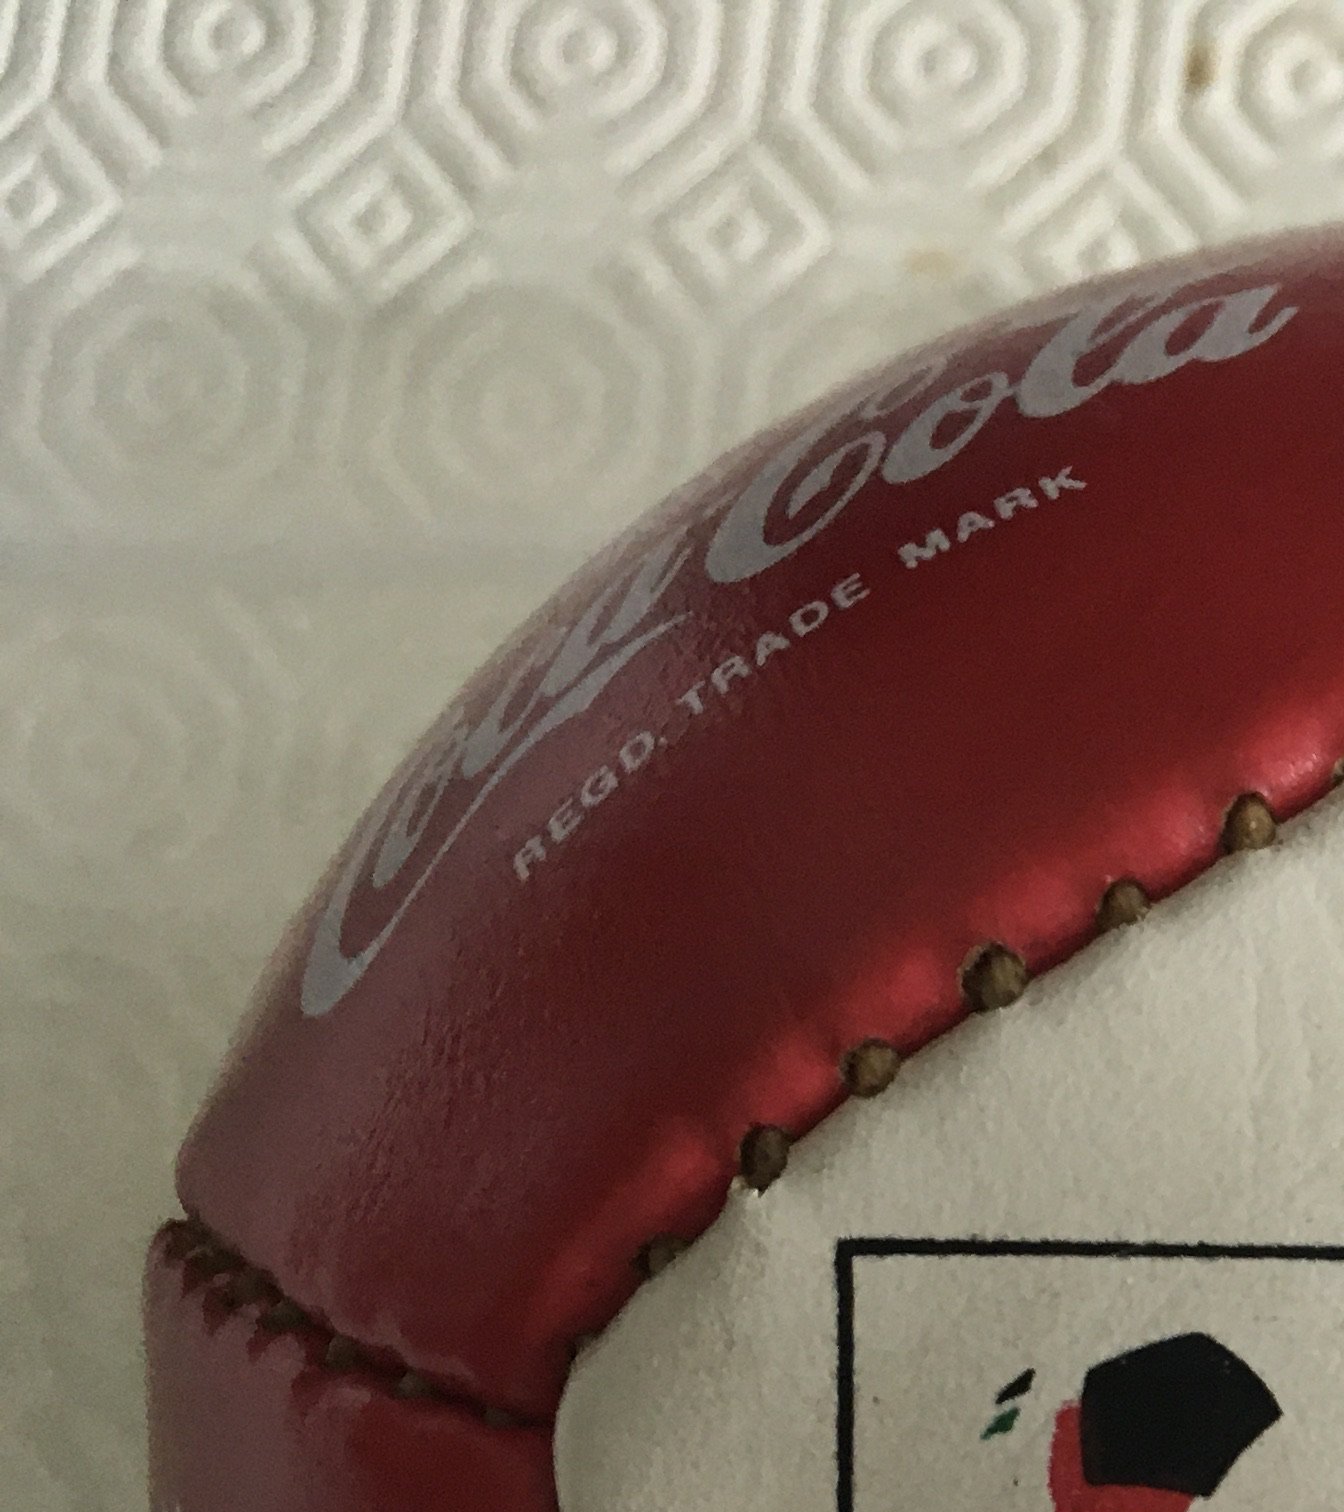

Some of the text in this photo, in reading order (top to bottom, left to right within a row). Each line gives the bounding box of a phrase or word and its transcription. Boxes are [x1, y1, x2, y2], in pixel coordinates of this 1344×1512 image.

[510, 465, 1088, 884] REGD. TRADE MARK
